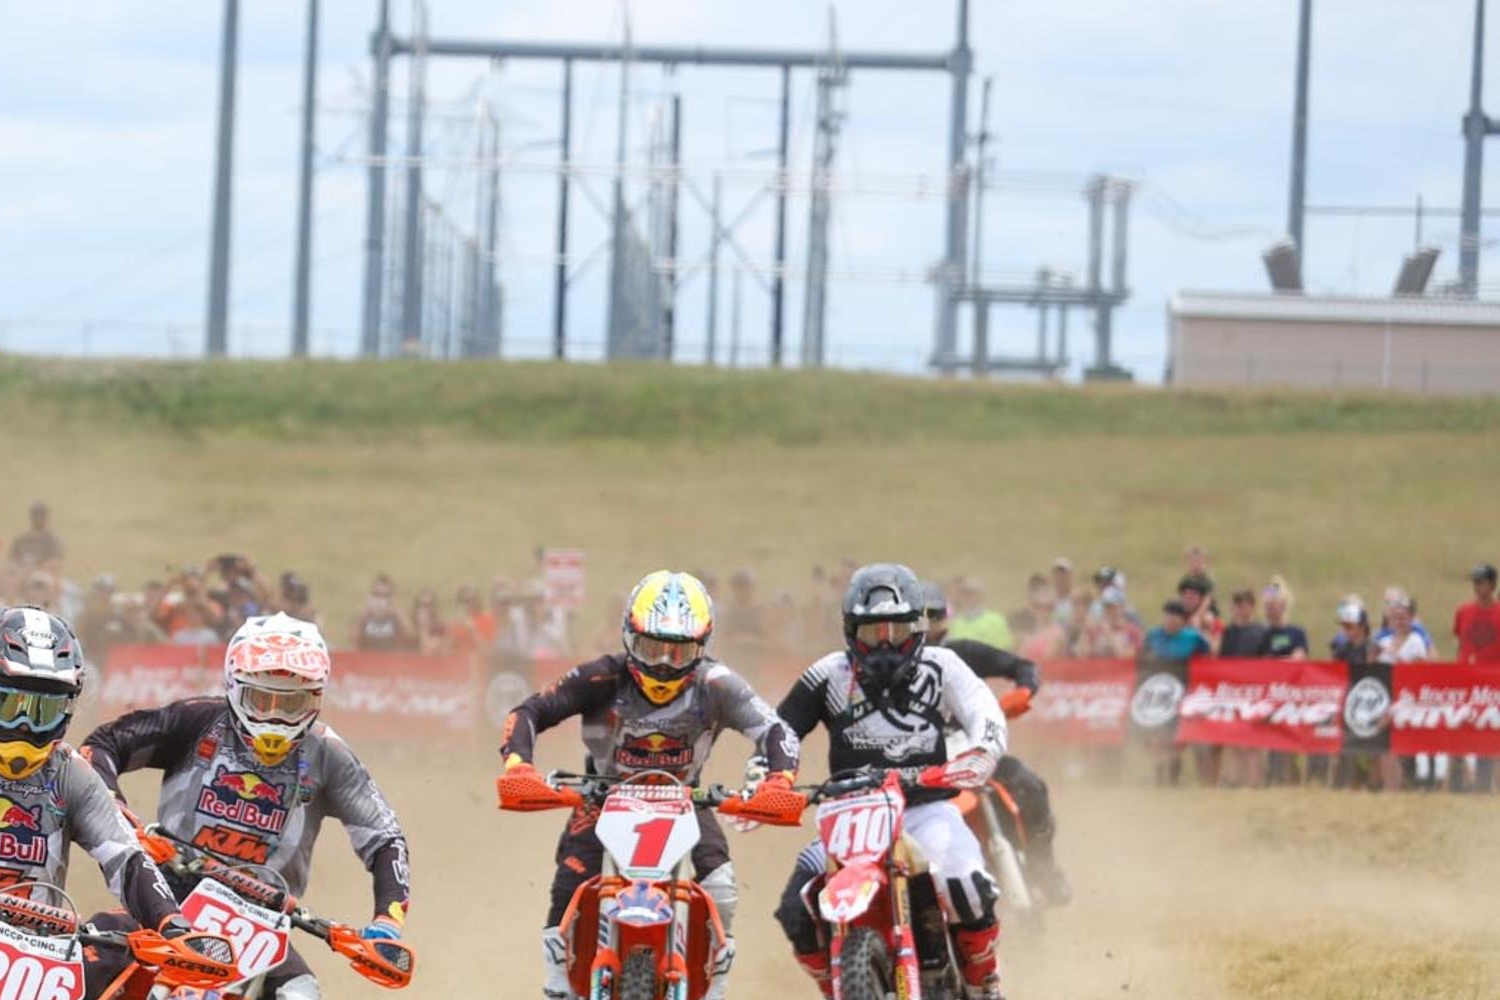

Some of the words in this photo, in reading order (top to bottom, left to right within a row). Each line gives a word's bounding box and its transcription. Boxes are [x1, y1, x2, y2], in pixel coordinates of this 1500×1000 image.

[615, 749, 653, 767] Red
[656, 748, 693, 766] Bull
[198, 787, 241, 822] Red
[242, 802, 286, 832] Bull
[192, 824, 270, 864] KTM
[629, 817, 676, 868] 1
[827, 806, 896, 862] 410
[193, 903, 279, 977] 530
[164, 957, 230, 978] ACERBIS
